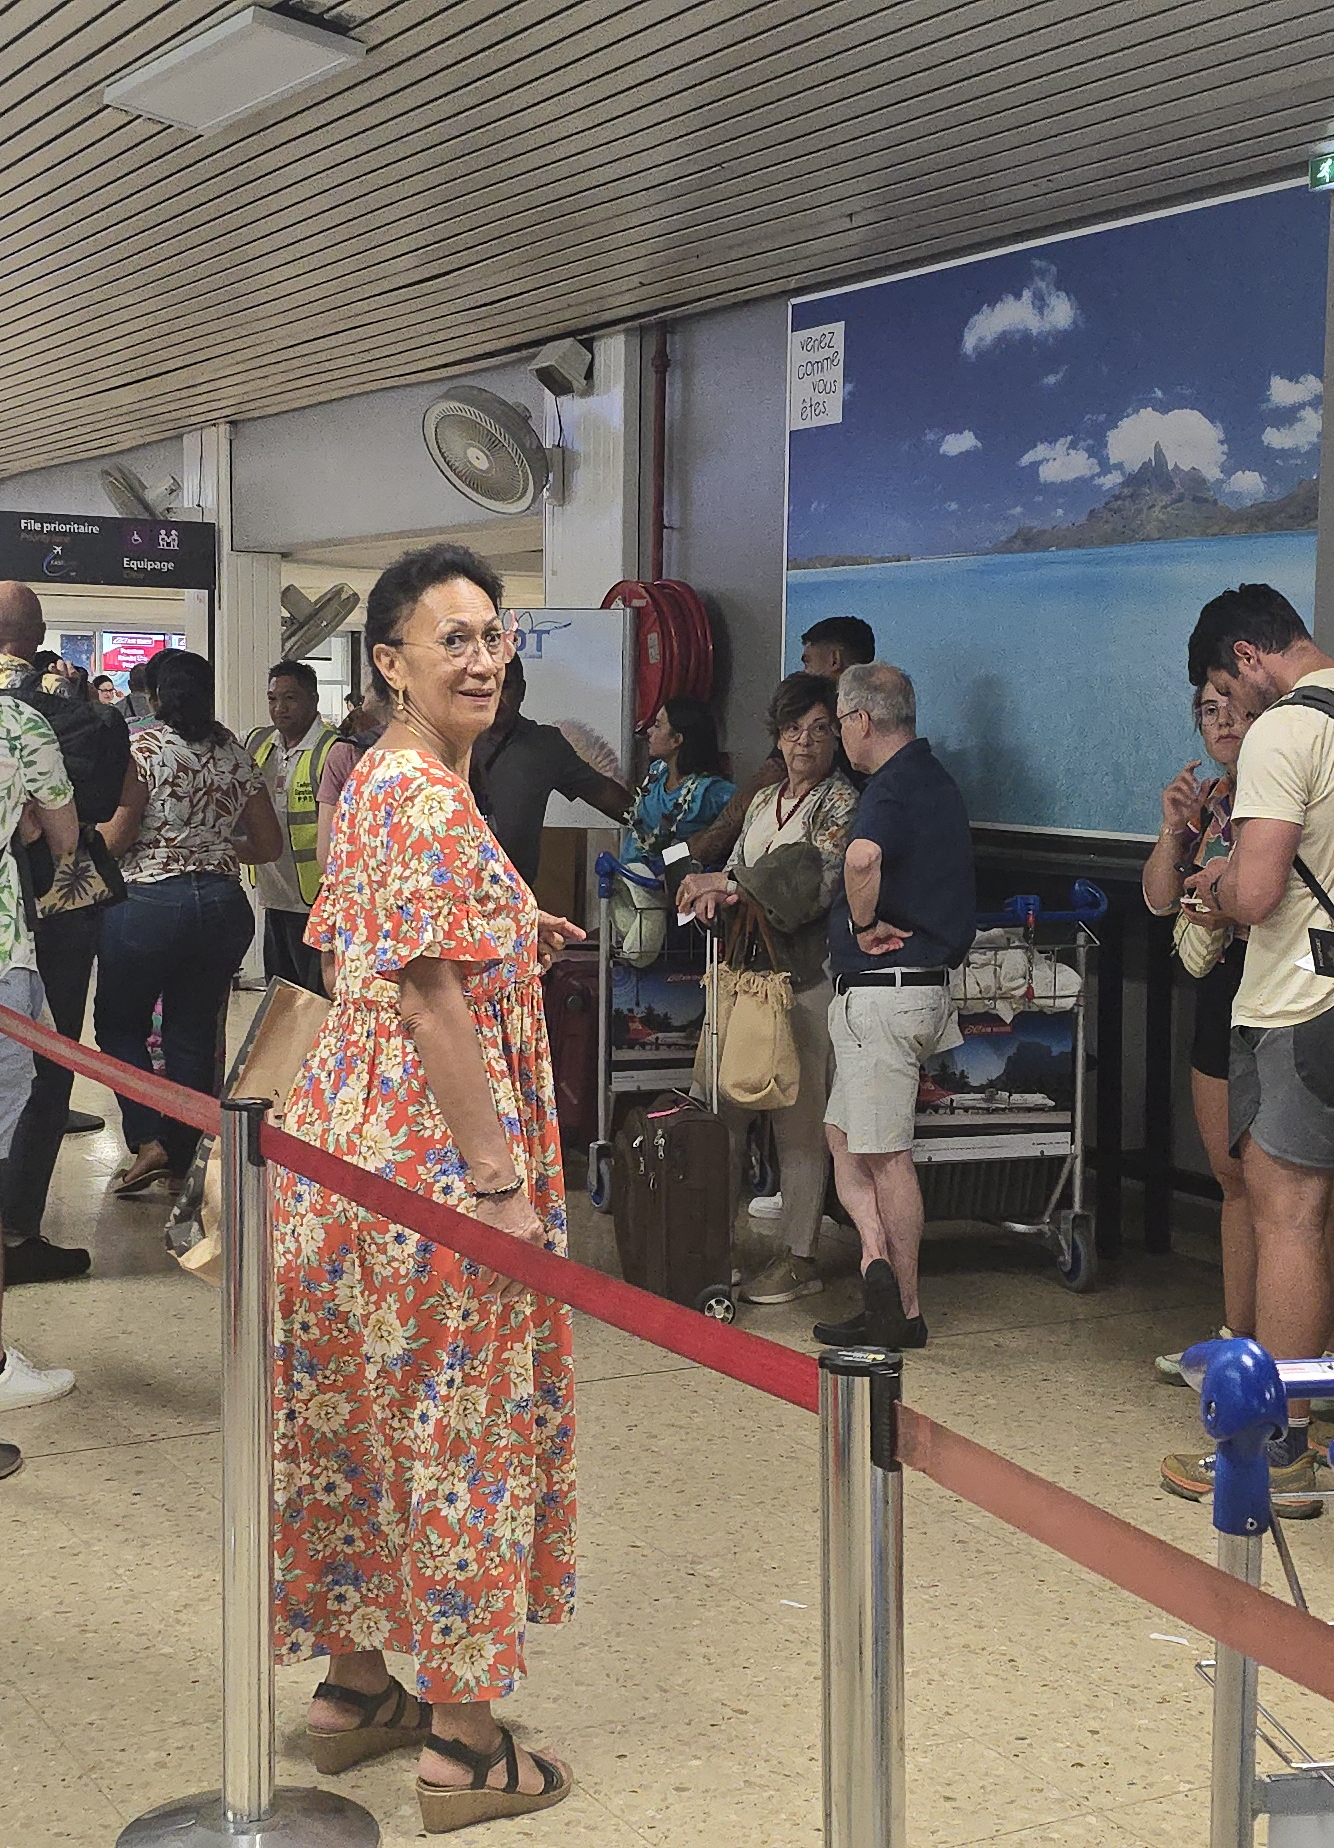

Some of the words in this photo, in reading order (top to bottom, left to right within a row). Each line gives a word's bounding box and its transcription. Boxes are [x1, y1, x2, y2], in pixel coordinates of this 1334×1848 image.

[799, 331, 835, 353] venez
[797, 350, 840, 380] comme
[812, 378, 838, 394] vous
[20, 519, 42, 530] File
[43, 520, 100, 534] prioritaire
[123, 557, 175, 572] Equipage
